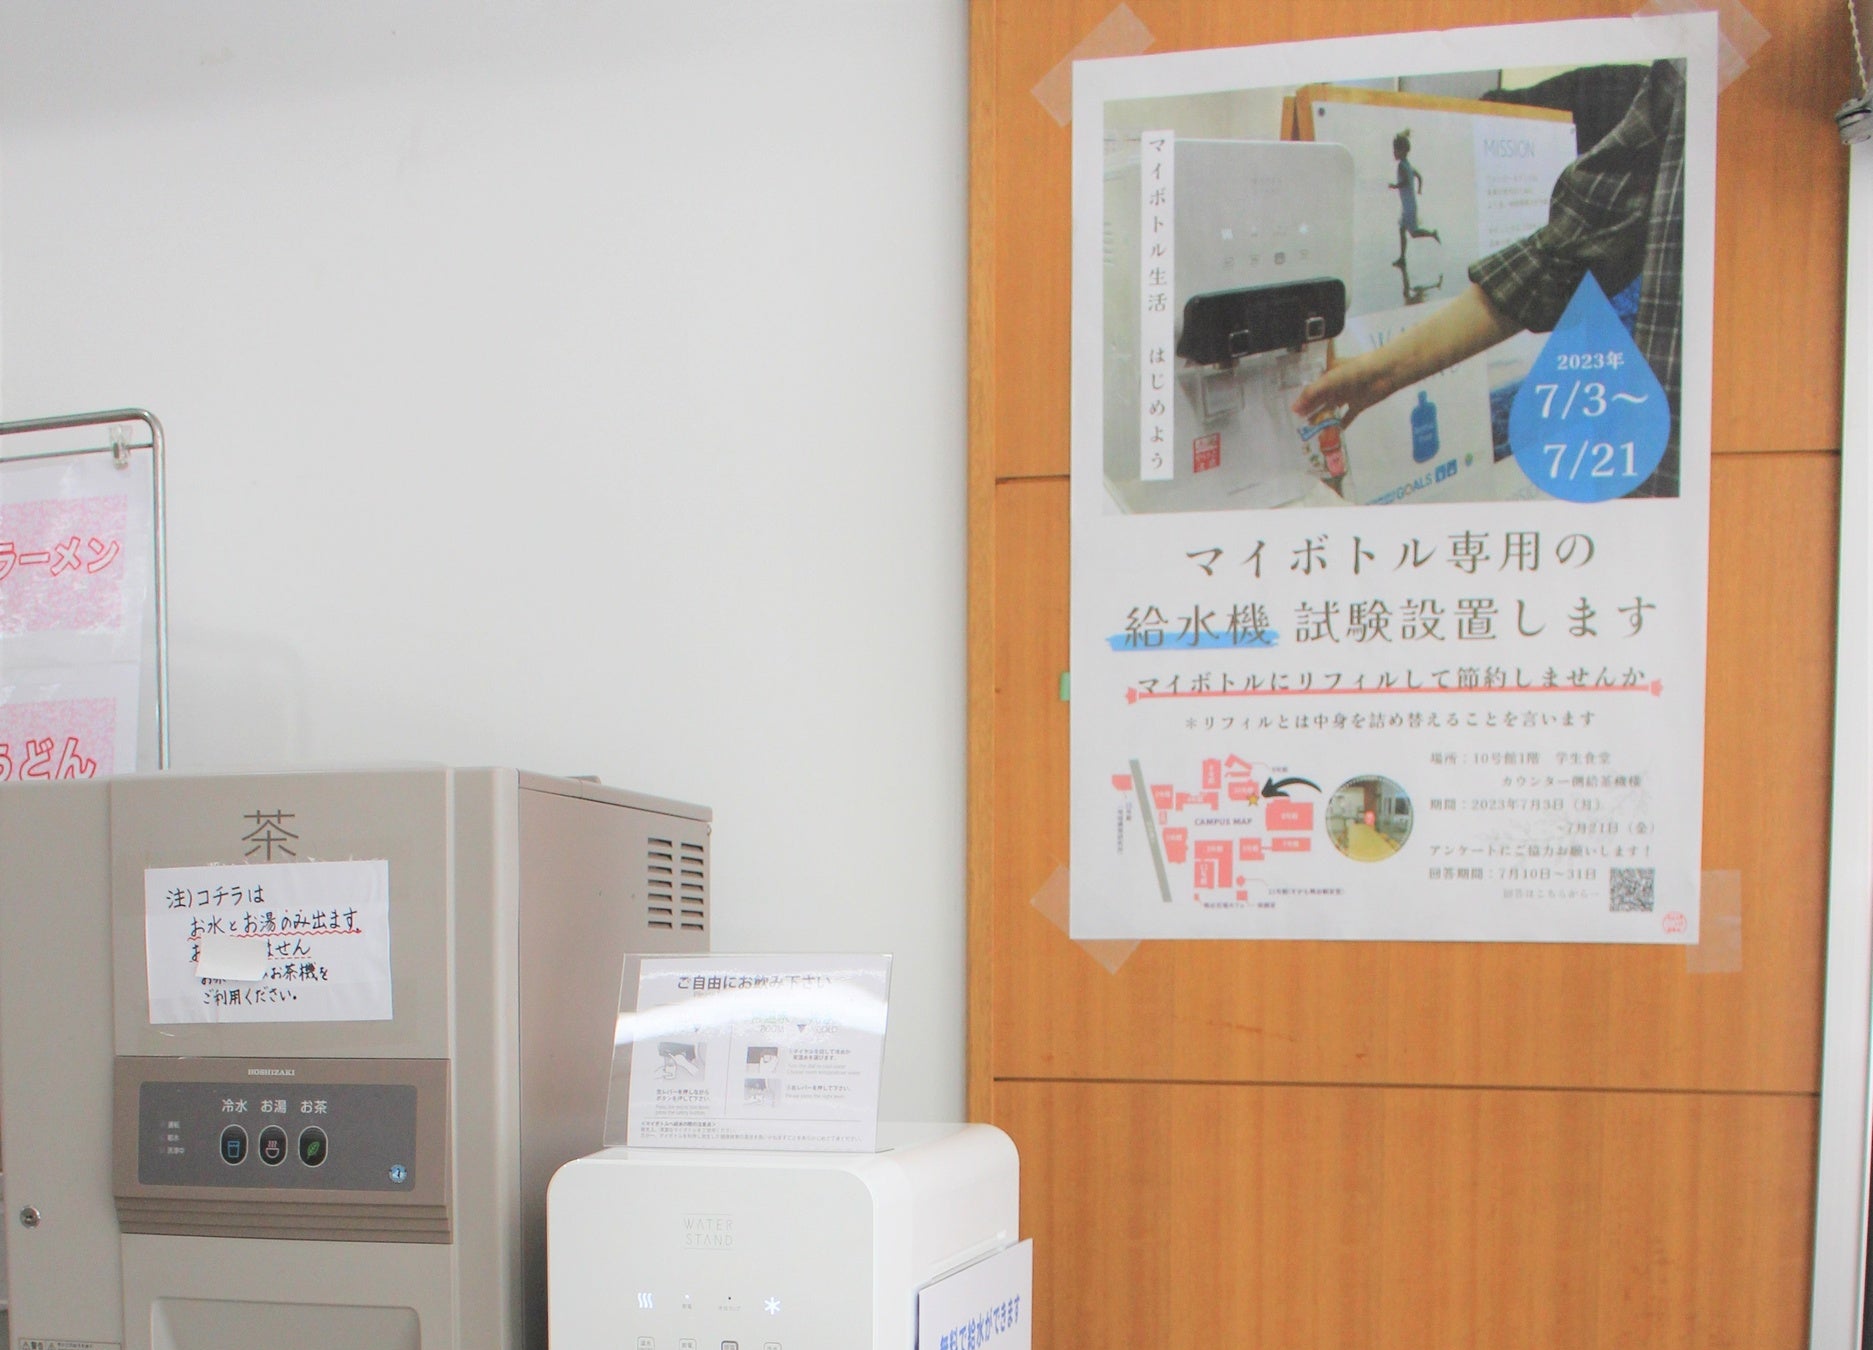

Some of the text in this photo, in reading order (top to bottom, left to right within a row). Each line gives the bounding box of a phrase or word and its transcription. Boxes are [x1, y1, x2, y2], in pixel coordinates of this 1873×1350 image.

[1148, 138, 1168, 471] マイボトル生活 はじめよう
[1556, 352, 1625, 371] 2023年
[1543, 441, 1640, 479] 7/21
[1185, 530, 1597, 579] マイボトル専用の
[1124, 595, 1658, 648] 給水機 試験設置します
[1137, 665, 1646, 696] マイボトルにリフィルして節約しませんか
[241, 809, 300, 861] 茶
[677, 975, 832, 991] ご自由にお飲み下さい
[247, 1069, 296, 1077] HOSHIZAKI
[221, 1099, 328, 1115] 冷水 お湯 お茶
[684, 1218, 734, 1231] WATER
[685, 1233, 734, 1246] STAND
